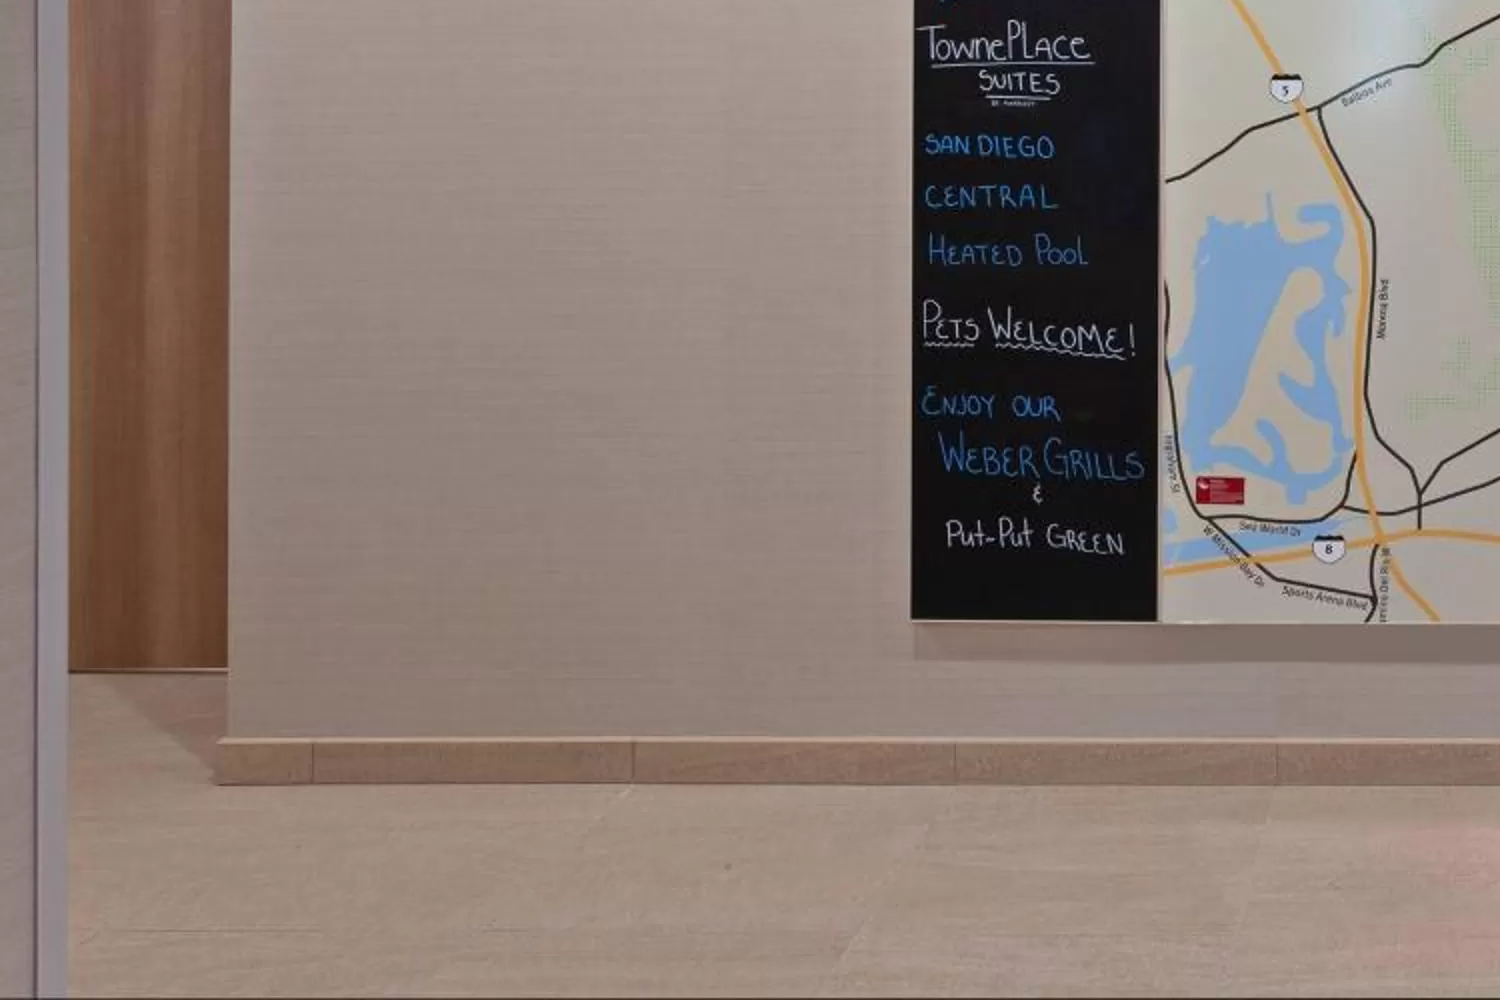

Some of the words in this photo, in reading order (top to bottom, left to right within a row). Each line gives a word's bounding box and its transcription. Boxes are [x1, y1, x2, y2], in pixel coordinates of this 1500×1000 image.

[979, 69, 1061, 95] SUITES
[1281, 84, 1290, 97] 5
[925, 132, 971, 155] SAN
[977, 134, 1057, 159] DIEGO
[925, 184, 1059, 209] CENTRAL
[929, 231, 1023, 267] HEATED
[923, 299, 980, 341] PETS
[921, 384, 995, 419] ENJOY
[1012, 395, 1062, 422] OUR
[938, 429, 1041, 479] WEBER
[1044, 436, 1146, 481] GRILLS
[1046, 523, 1125, 556] GREEN
[1325, 543, 1333, 555] 8
